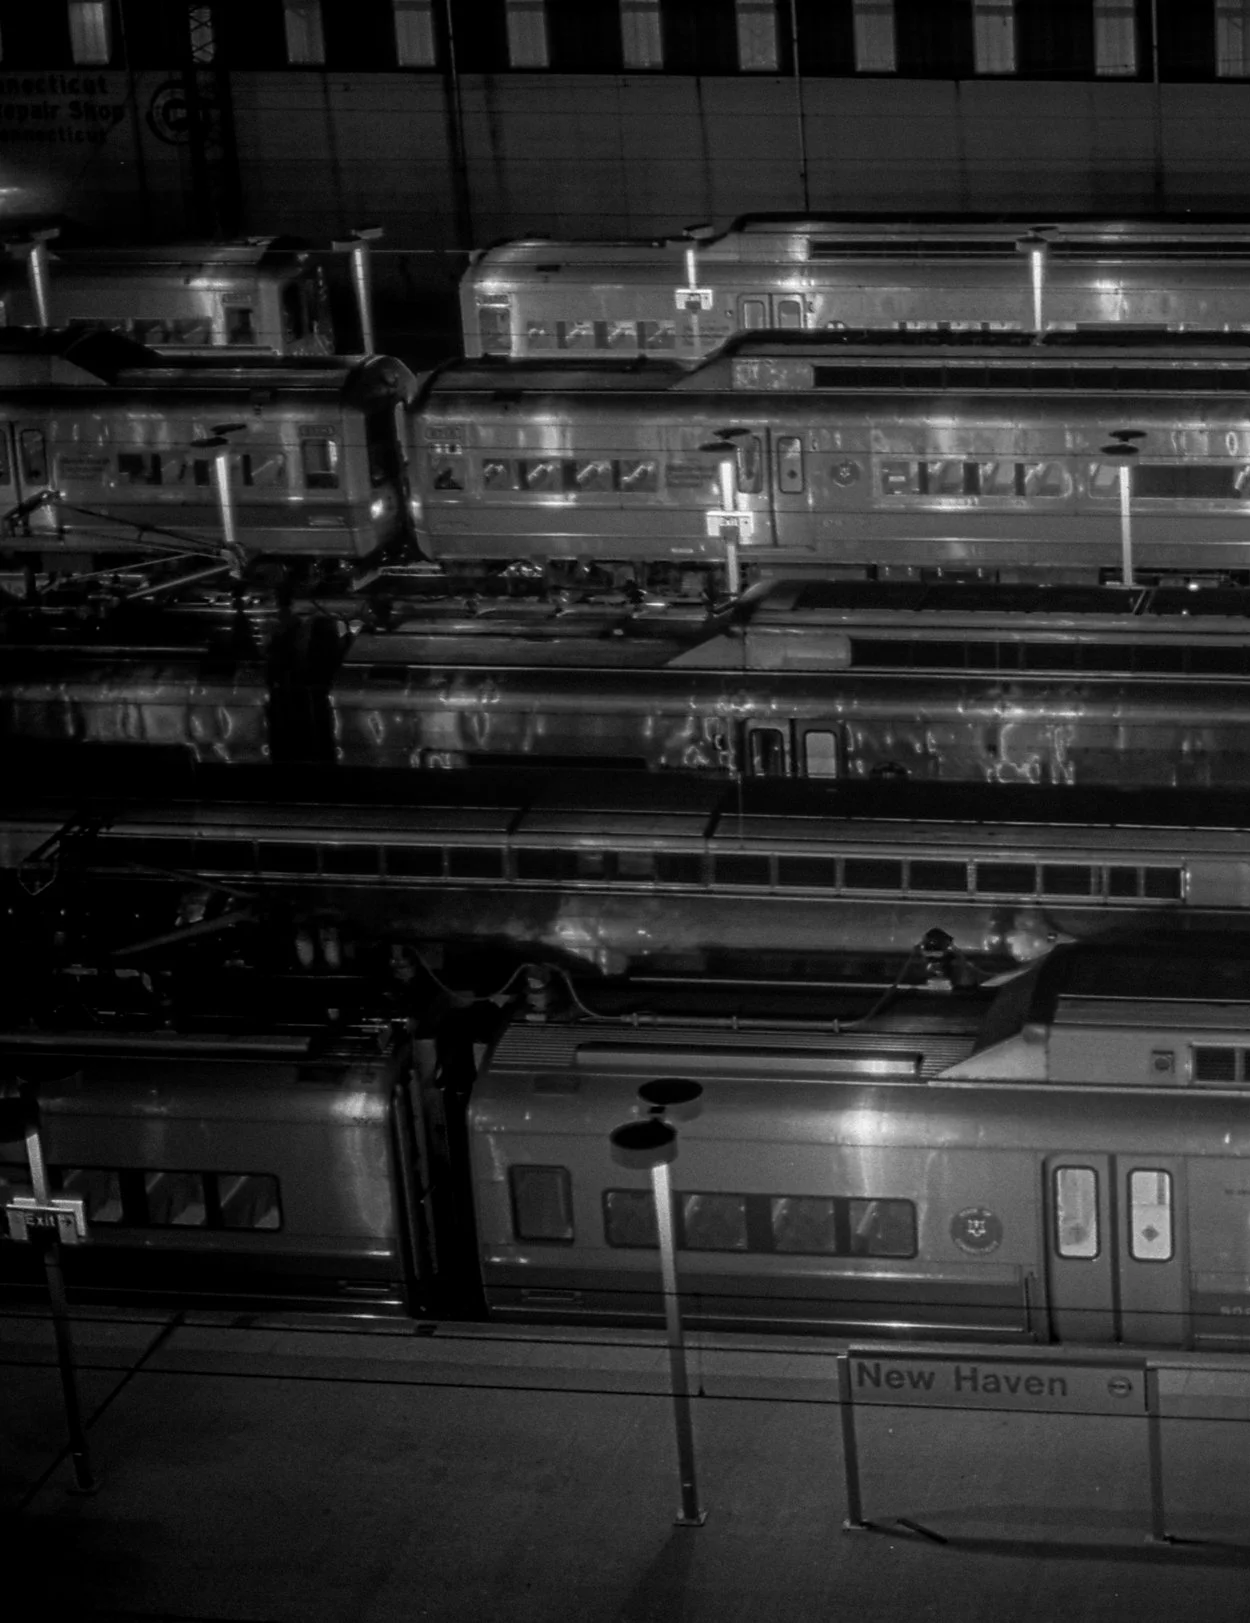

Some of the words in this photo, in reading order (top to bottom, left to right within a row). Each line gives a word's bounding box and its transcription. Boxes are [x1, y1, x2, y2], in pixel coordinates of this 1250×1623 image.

[0, 101, 60, 123] epair
[69, 101, 124, 125] Shop
[26, 1213, 56, 1228] Exit
[856, 1362, 935, 1390] New
[954, 1365, 1068, 1396] Haven
